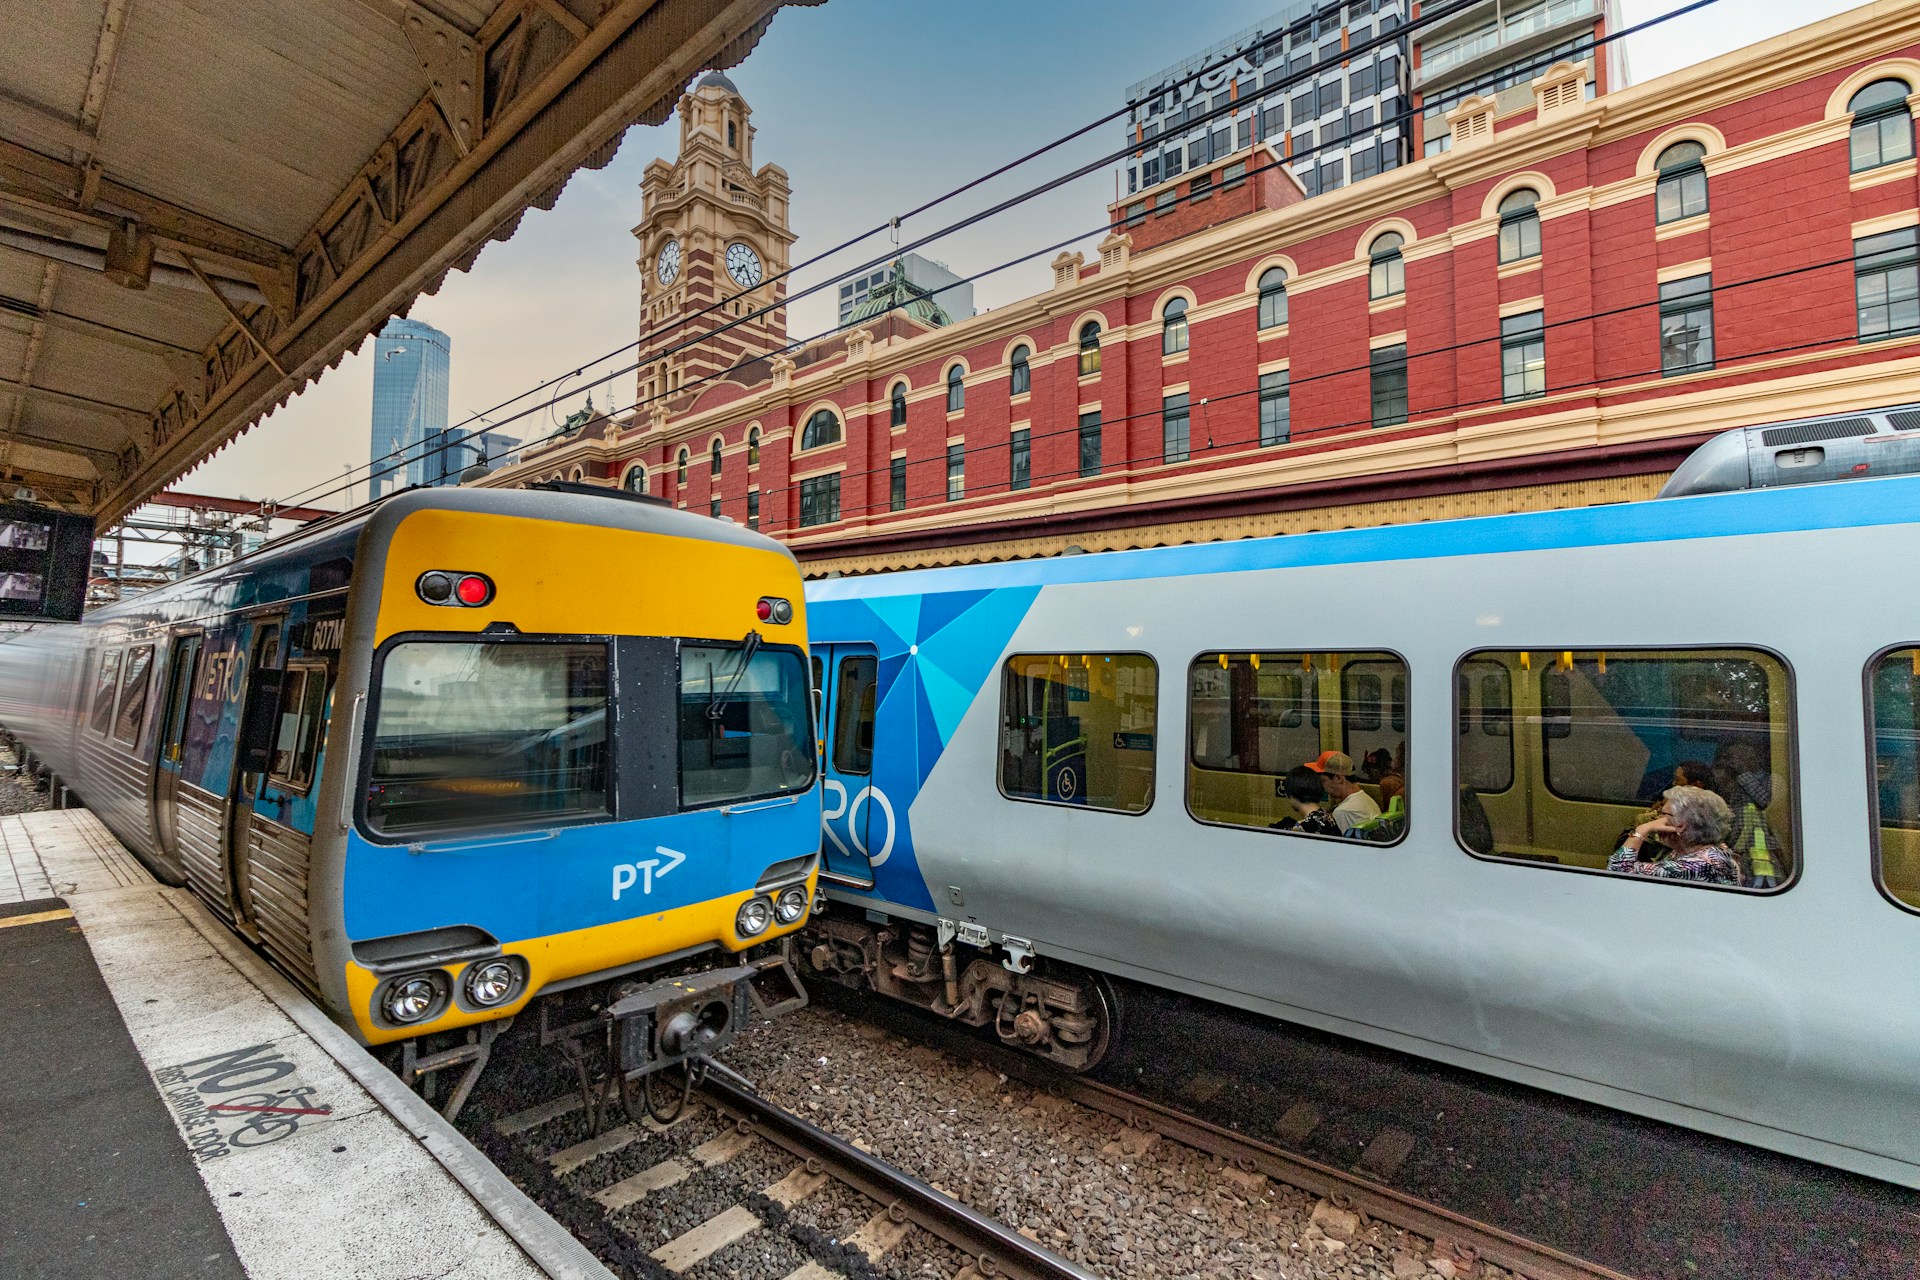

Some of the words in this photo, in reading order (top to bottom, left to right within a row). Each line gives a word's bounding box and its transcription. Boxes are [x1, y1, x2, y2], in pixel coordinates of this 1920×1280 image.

[312, 618, 345, 650] 607M
[194, 651, 246, 704] METRO
[155, 1065, 190, 1088] FIRST
[182, 1043, 297, 1094] NO
[167, 1086, 216, 1131] CARRIAGE
[189, 1127, 231, 1164] DOOR
